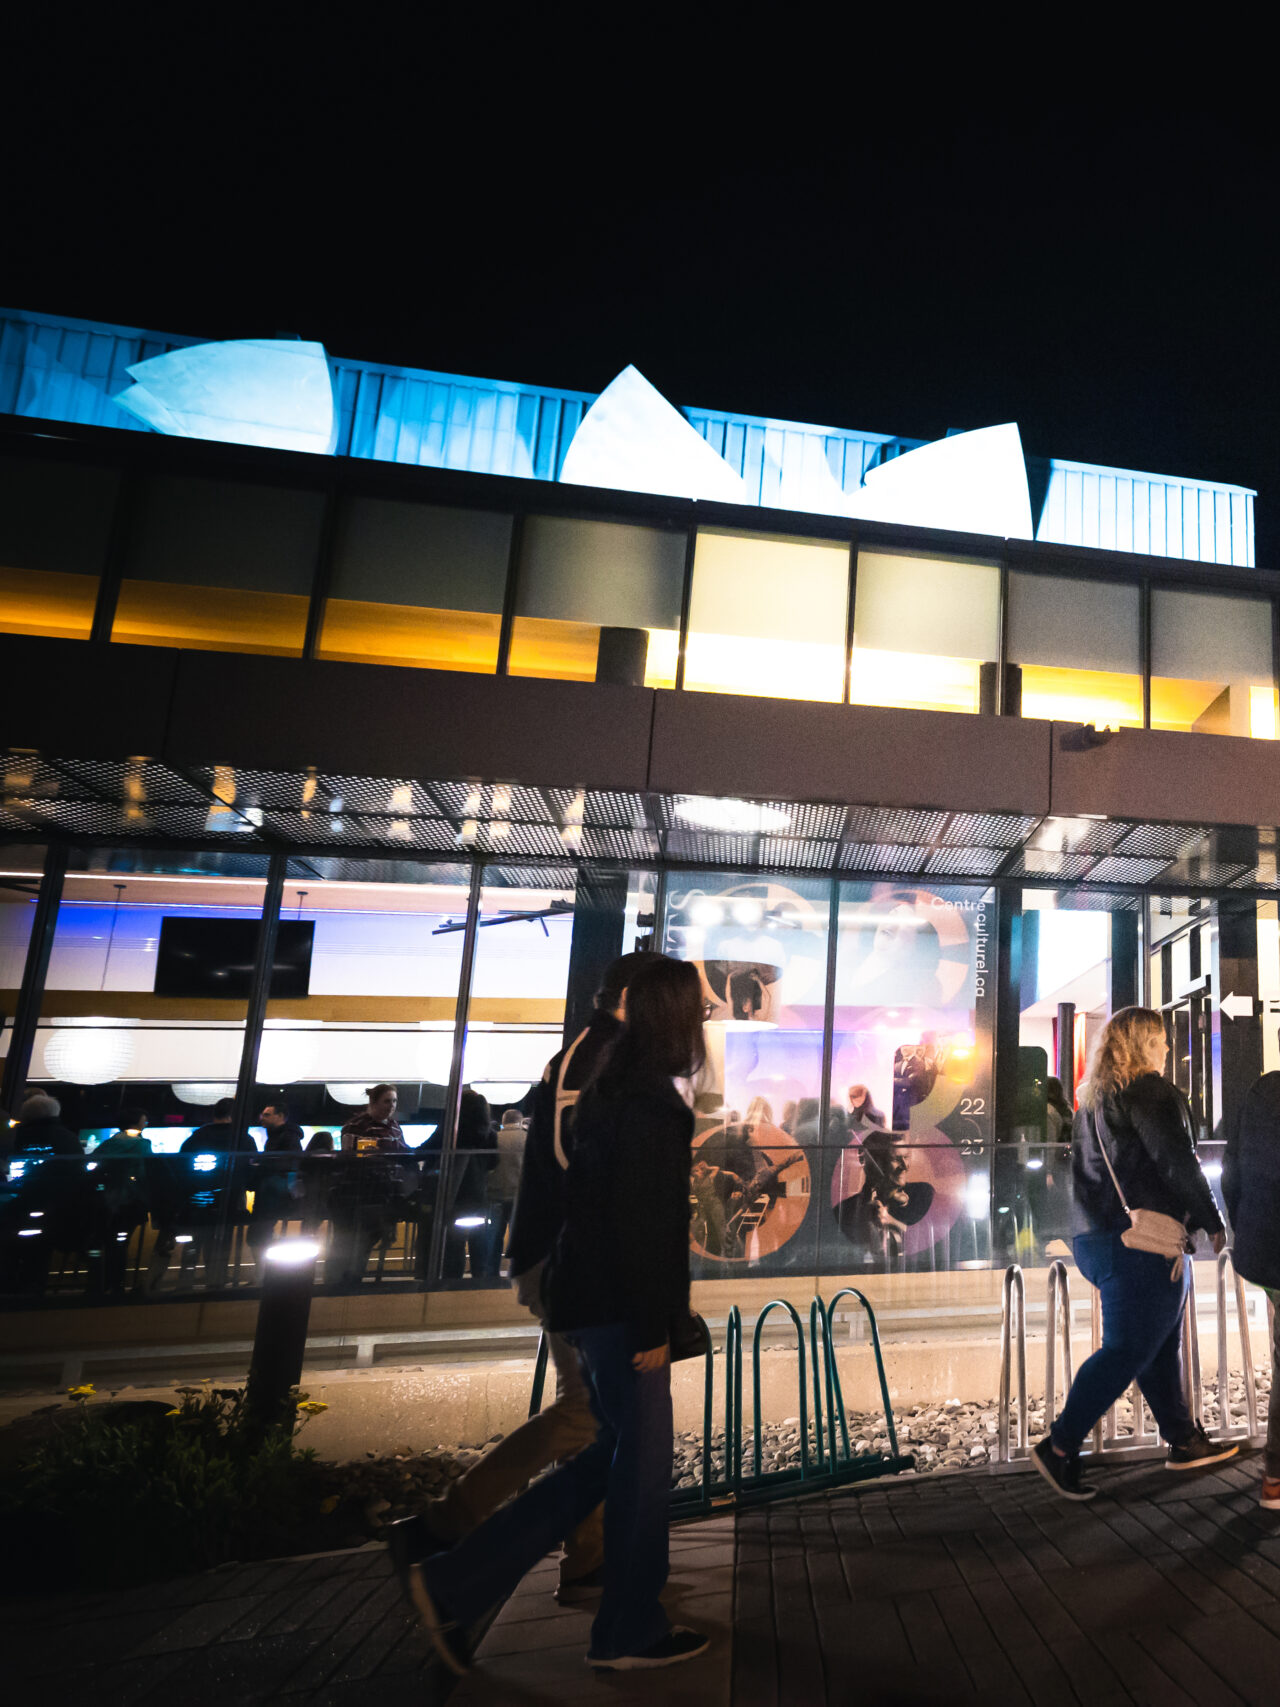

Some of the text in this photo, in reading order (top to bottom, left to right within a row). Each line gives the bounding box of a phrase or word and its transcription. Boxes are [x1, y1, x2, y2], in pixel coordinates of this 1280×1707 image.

[930, 896, 986, 912] Centre
[975, 912, 990, 997] culturel.ca
[959, 1097, 986, 1116] 22
